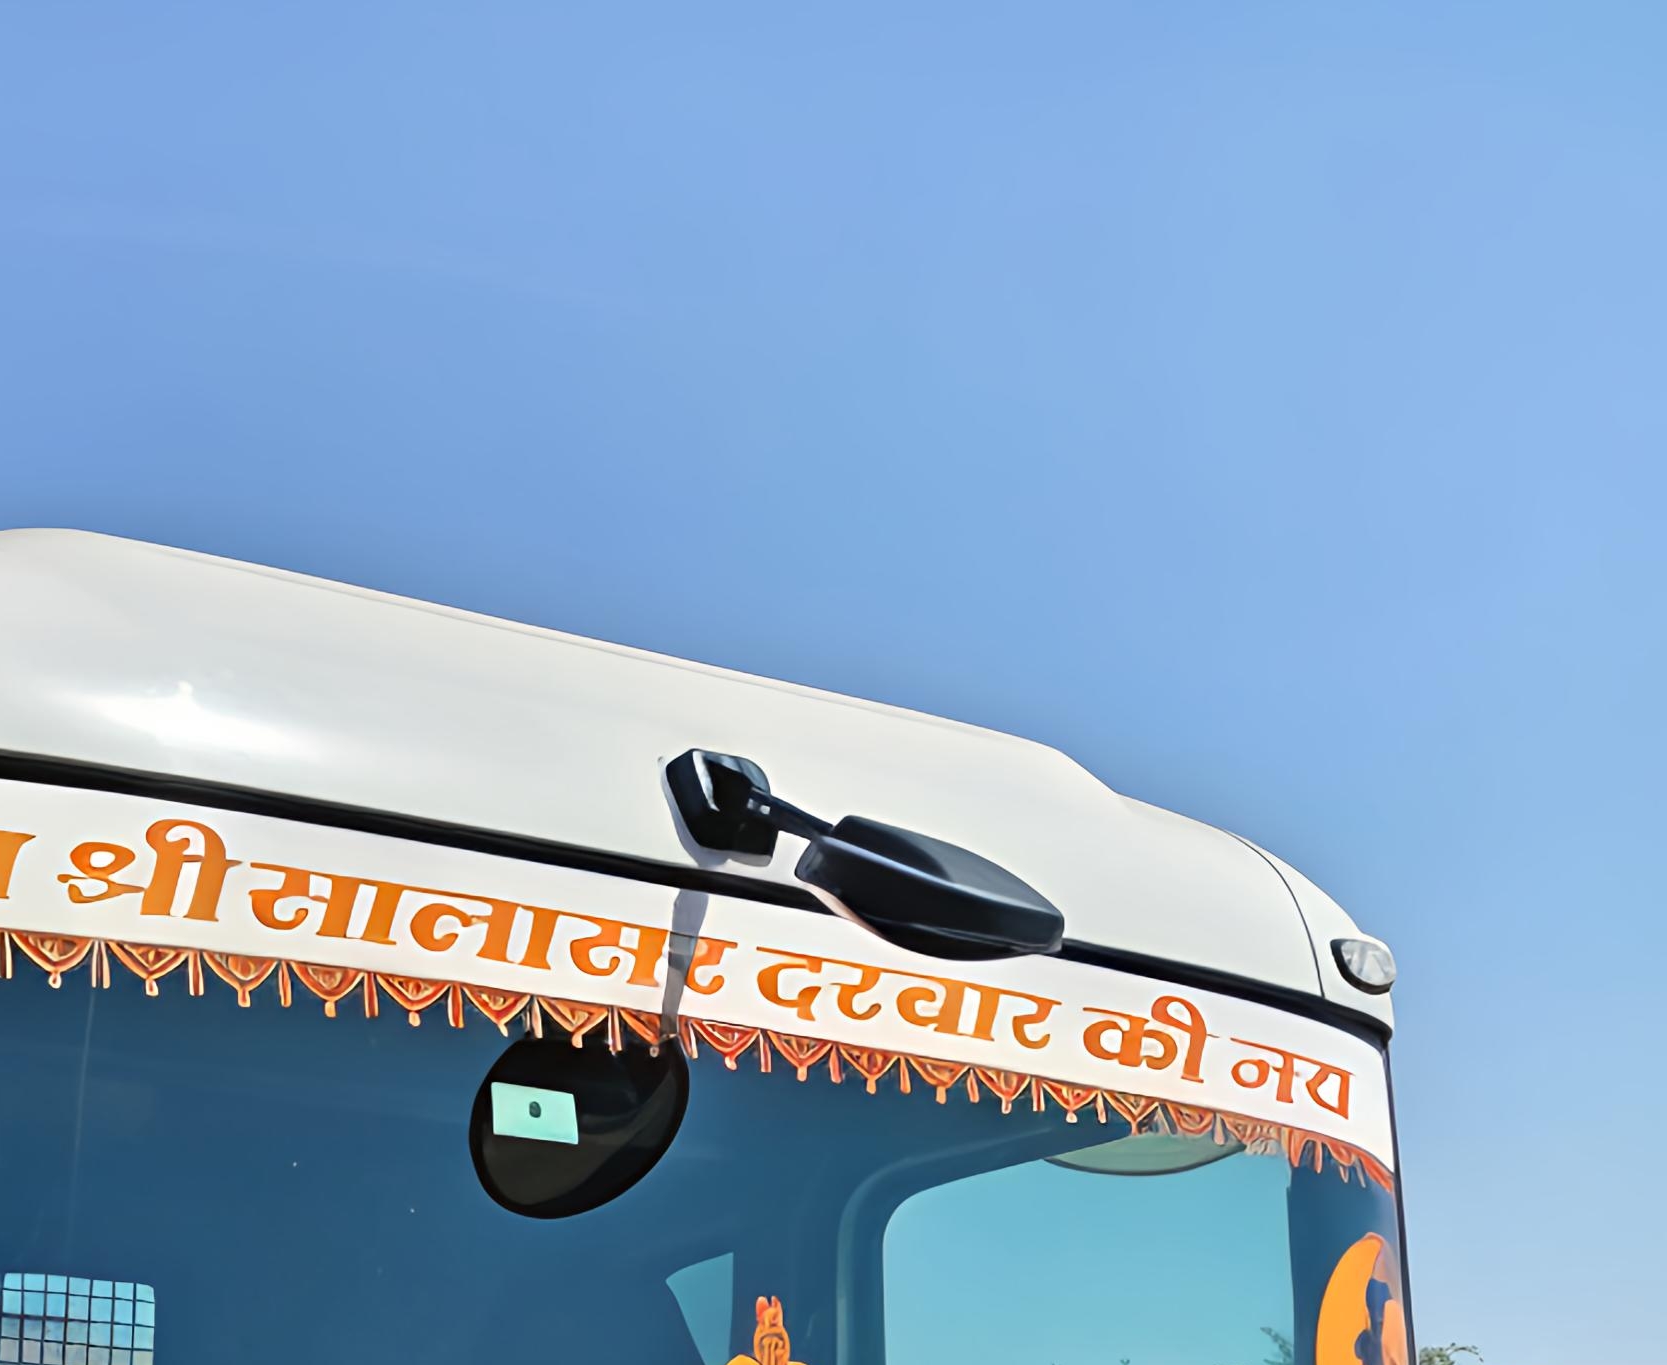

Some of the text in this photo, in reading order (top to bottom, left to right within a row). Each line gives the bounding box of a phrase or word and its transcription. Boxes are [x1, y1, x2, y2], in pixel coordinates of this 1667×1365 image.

[56, 818, 242, 922] श्री
[248, 861, 739, 995] सालासर
[1082, 995, 1219, 1084] की
